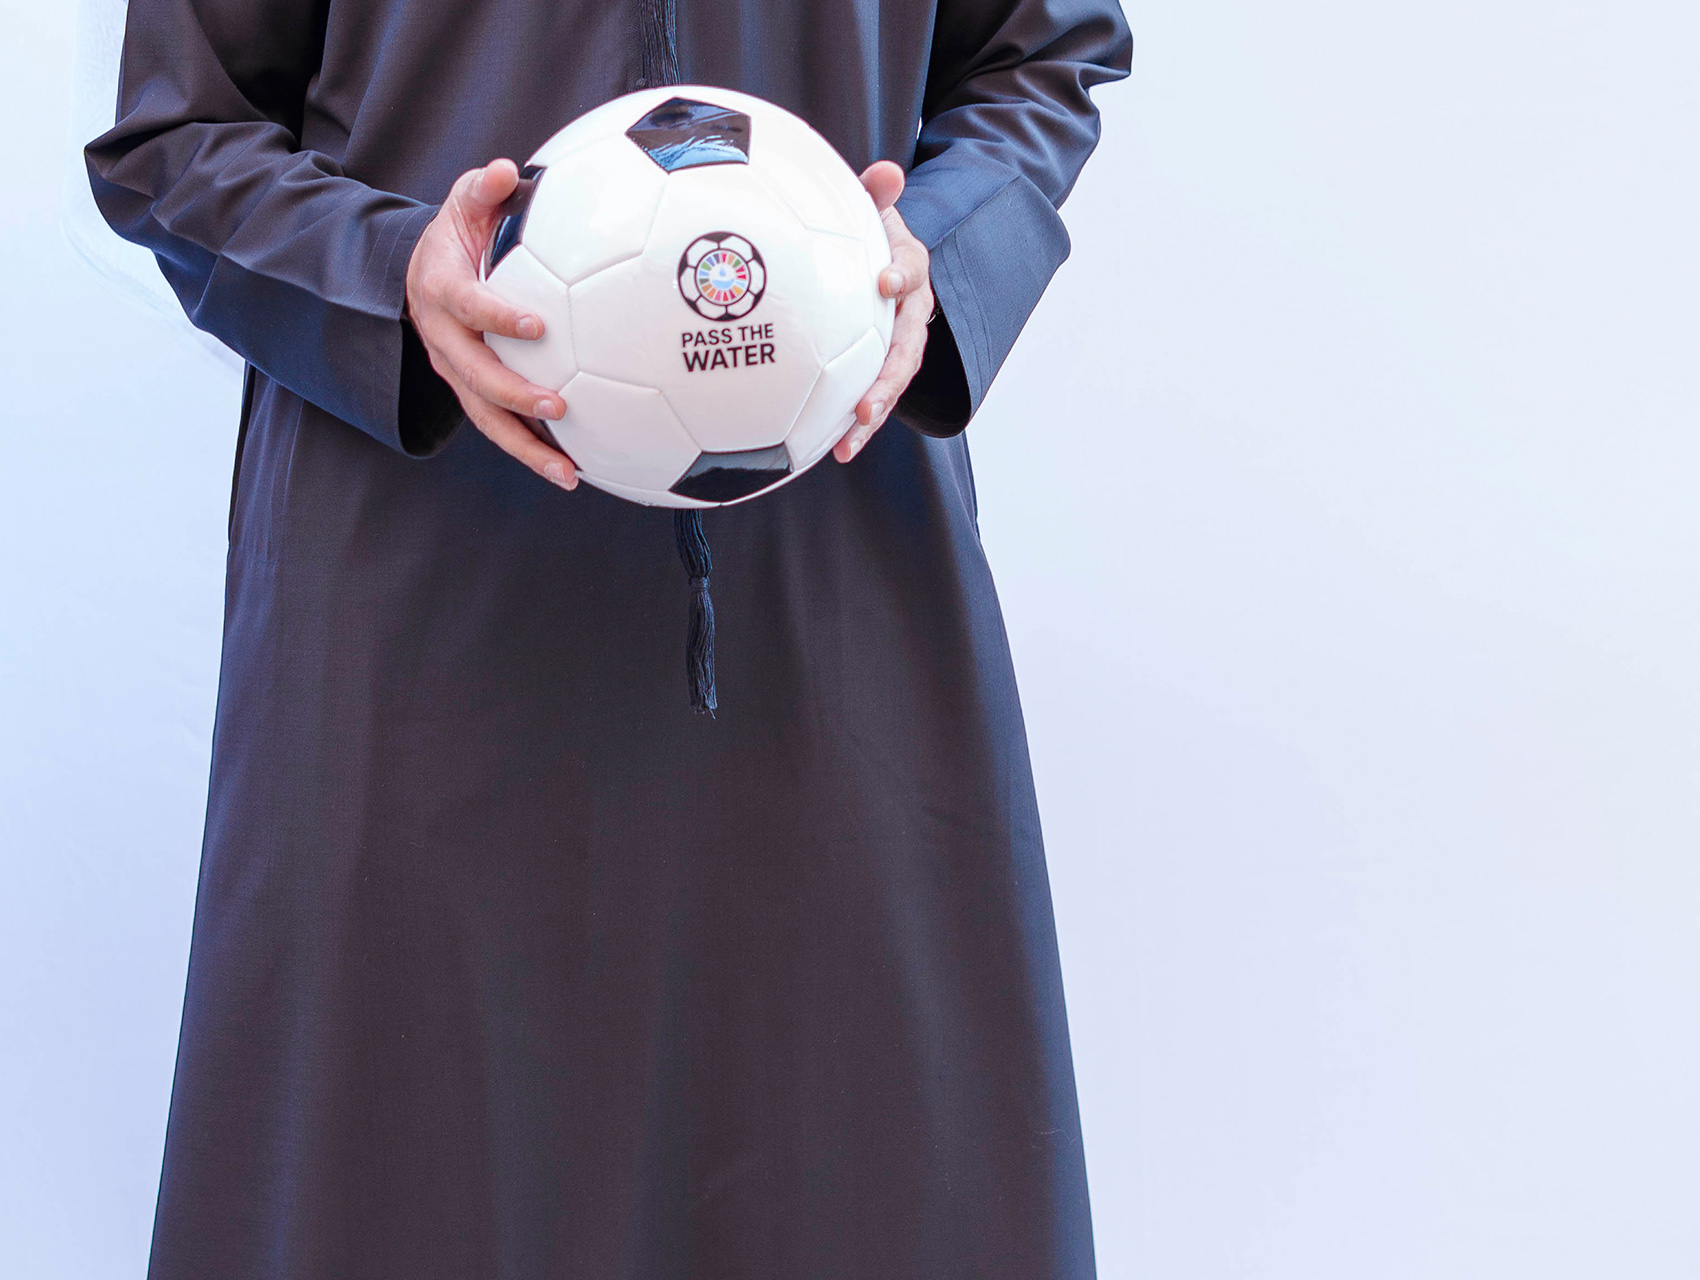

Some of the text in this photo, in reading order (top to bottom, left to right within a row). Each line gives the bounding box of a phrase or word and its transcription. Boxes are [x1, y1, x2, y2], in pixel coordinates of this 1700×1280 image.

[682, 323, 774, 348] PASS THE
[683, 343, 775, 372] WATER
